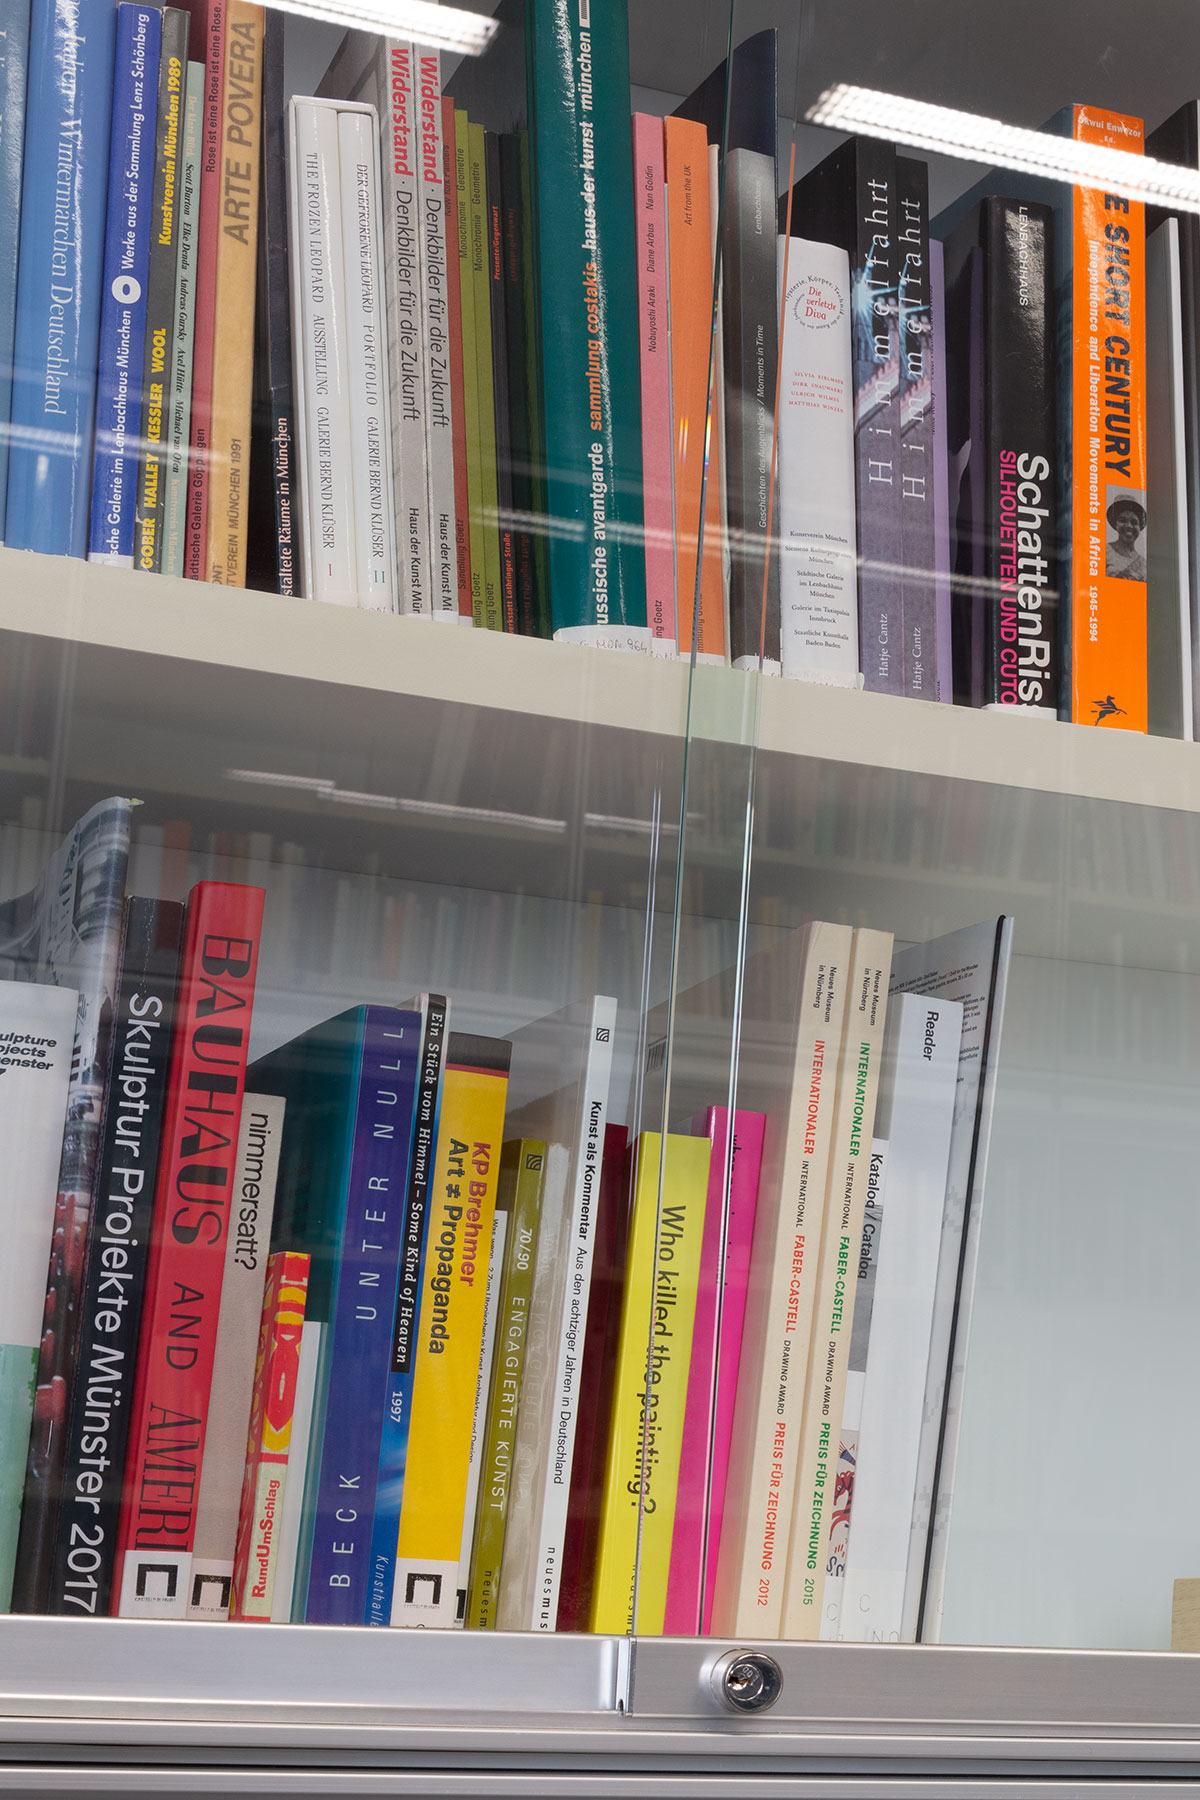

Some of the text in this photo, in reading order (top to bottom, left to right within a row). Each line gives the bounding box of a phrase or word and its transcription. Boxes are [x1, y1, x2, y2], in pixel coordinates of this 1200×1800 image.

[121, 13, 149, 269] Werke aus der Sammlung Lenz Schönberg
[158, 57, 181, 245] Kunstverein München 1989
[223, 20, 258, 246] ARTE POVERA
[574, 31, 593, 109] münchen
[579, 121, 595, 168] kunst
[391, 48, 420, 421] Widerstand Denkbilder für die Zukunft
[583, 261, 600, 333] costakis
[805, 307, 827, 320] Diva
[806, 298, 837, 311] verletzte
[808, 286, 822, 297] Die
[107, 310, 131, 524] Galerie im Lenbachhaus München
[586, 339, 606, 430] sammlung
[864, 178, 894, 484] Himmelfahrt
[898, 197, 927, 500] Himmelfahrt
[1105, 223, 1130, 478] SHORT CENTURY
[139, 328, 168, 568] GOBER HALLEY KESSLER WOOL
[588, 443, 613, 539] avantgarde
[999, 450, 1016, 641] SILHOUETTEN UND
[1014, 451, 1053, 706] SchattenRis
[171, 934, 252, 1245] BAUHAUS
[849, 1042, 870, 1156] INTERNATIONALER
[923, 1011, 939, 1061] Reader
[234, 1112, 269, 1270] nimmersatt?
[355, 1027, 404, 1320] UNTER NULL
[396, 1013, 443, 1364] Ein Stück vom Himmel Some Kind of Heaven
[428, 1138, 469, 1354] Art Propaganda
[459, 1141, 491, 1287] KP Brehmer
[578, 1101, 602, 1240] Kunst als Kommentar
[857, 1153, 883, 1279] Katalog Catalog
[62, 992, 162, 1613] Skulptur Projekte Münster 2017
[166, 1281, 204, 1370] AND
[626, 1202, 687, 1515] Who killed the painting?
[830, 1236, 850, 1334] FABER-CASTELL
[490, 1297, 525, 1511] ENGAGIERTE KUNST
[251, 1479, 280, 1598] RundUmSchlag
[329, 1474, 360, 1587] BECK
[802, 1422, 830, 1605] PREIS FÜR ZEICHNUNG 2015
